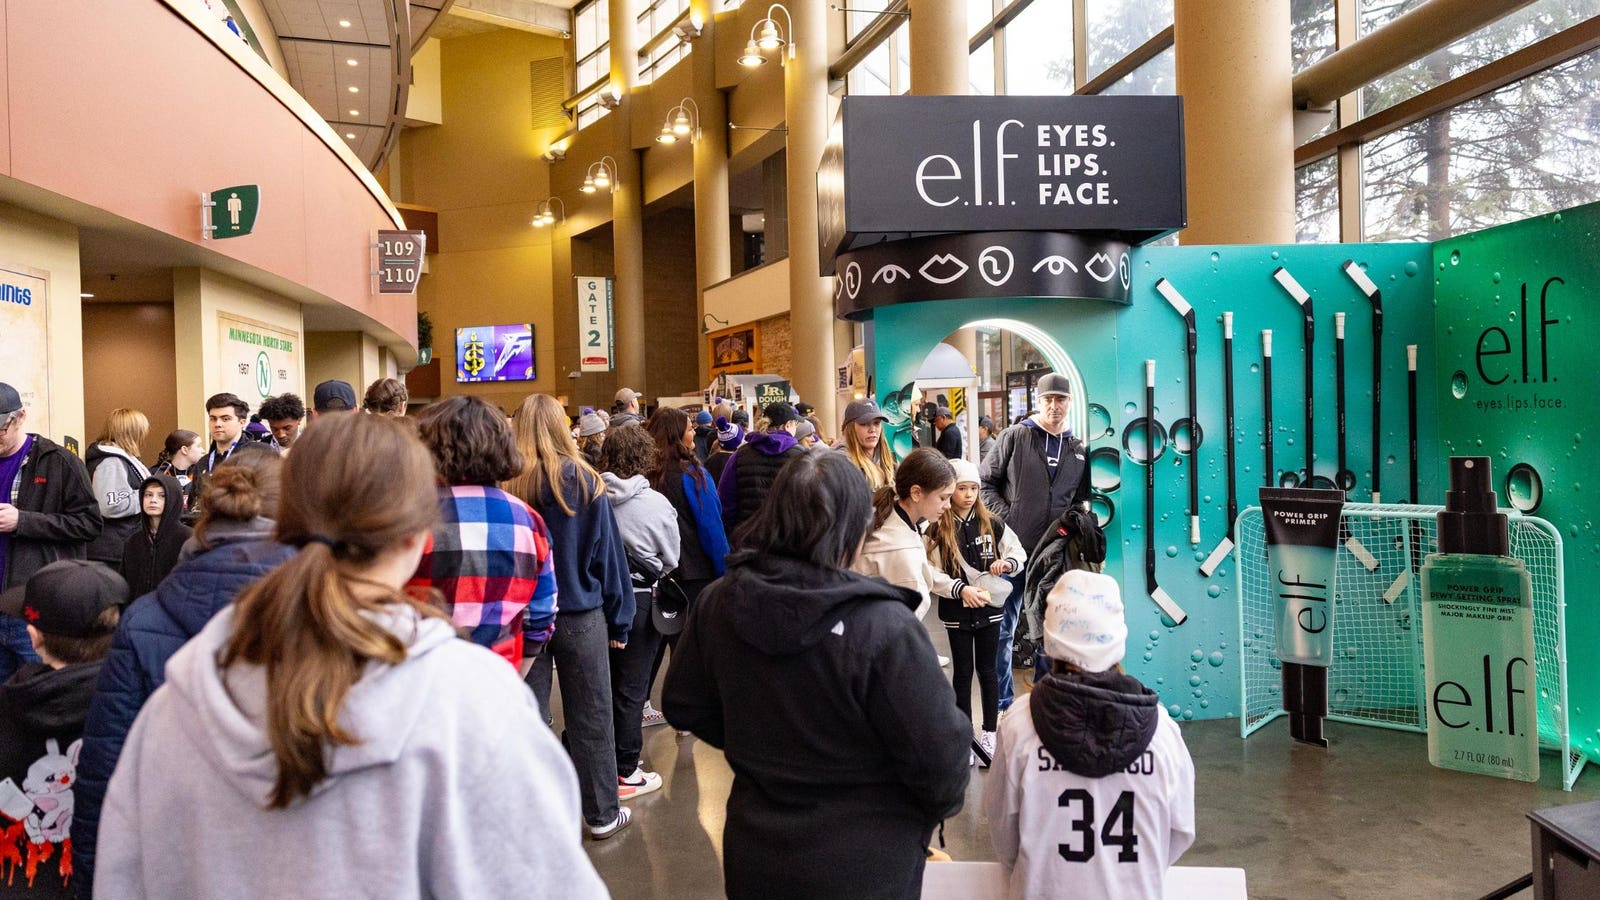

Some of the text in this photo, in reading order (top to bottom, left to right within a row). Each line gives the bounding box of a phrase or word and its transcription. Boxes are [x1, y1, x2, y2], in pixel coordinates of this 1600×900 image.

[1037, 124, 1116, 147] EYES.
[915, 119, 1025, 207] e.l.f.
[1037, 153, 1108, 176] LIPS.
[1038, 182, 1119, 205] FACE.
[384, 240, 414, 256] 109
[385, 268, 415, 283] 110
[228, 327, 293, 352] MINNESOTA NORTH STARS
[587, 329, 601, 347] 2
[1475, 276, 1566, 386] e.l.f.
[758, 395, 788, 404] DOUGH
[1274, 510, 1304, 519] POWER
[1285, 518, 1317, 526] PRIMER
[1430, 591, 1453, 599] DEWY
[1456, 593, 1494, 602] SETTING
[1446, 584, 1504, 594] POWER GRIP
[1278, 569, 1327, 634] e.l.f.
[1438, 603, 1480, 612] SHOCKINGLY
[1482, 606, 1498, 614] FINE
[1432, 654, 1529, 737] e.l.f.
[1454, 750, 1465, 761] 2.7
[1466, 751, 1475, 762] FL
[1476, 753, 1486, 764] OZ
[1488, 754, 1501, 767] (80
[1057, 788, 1139, 863] 34
